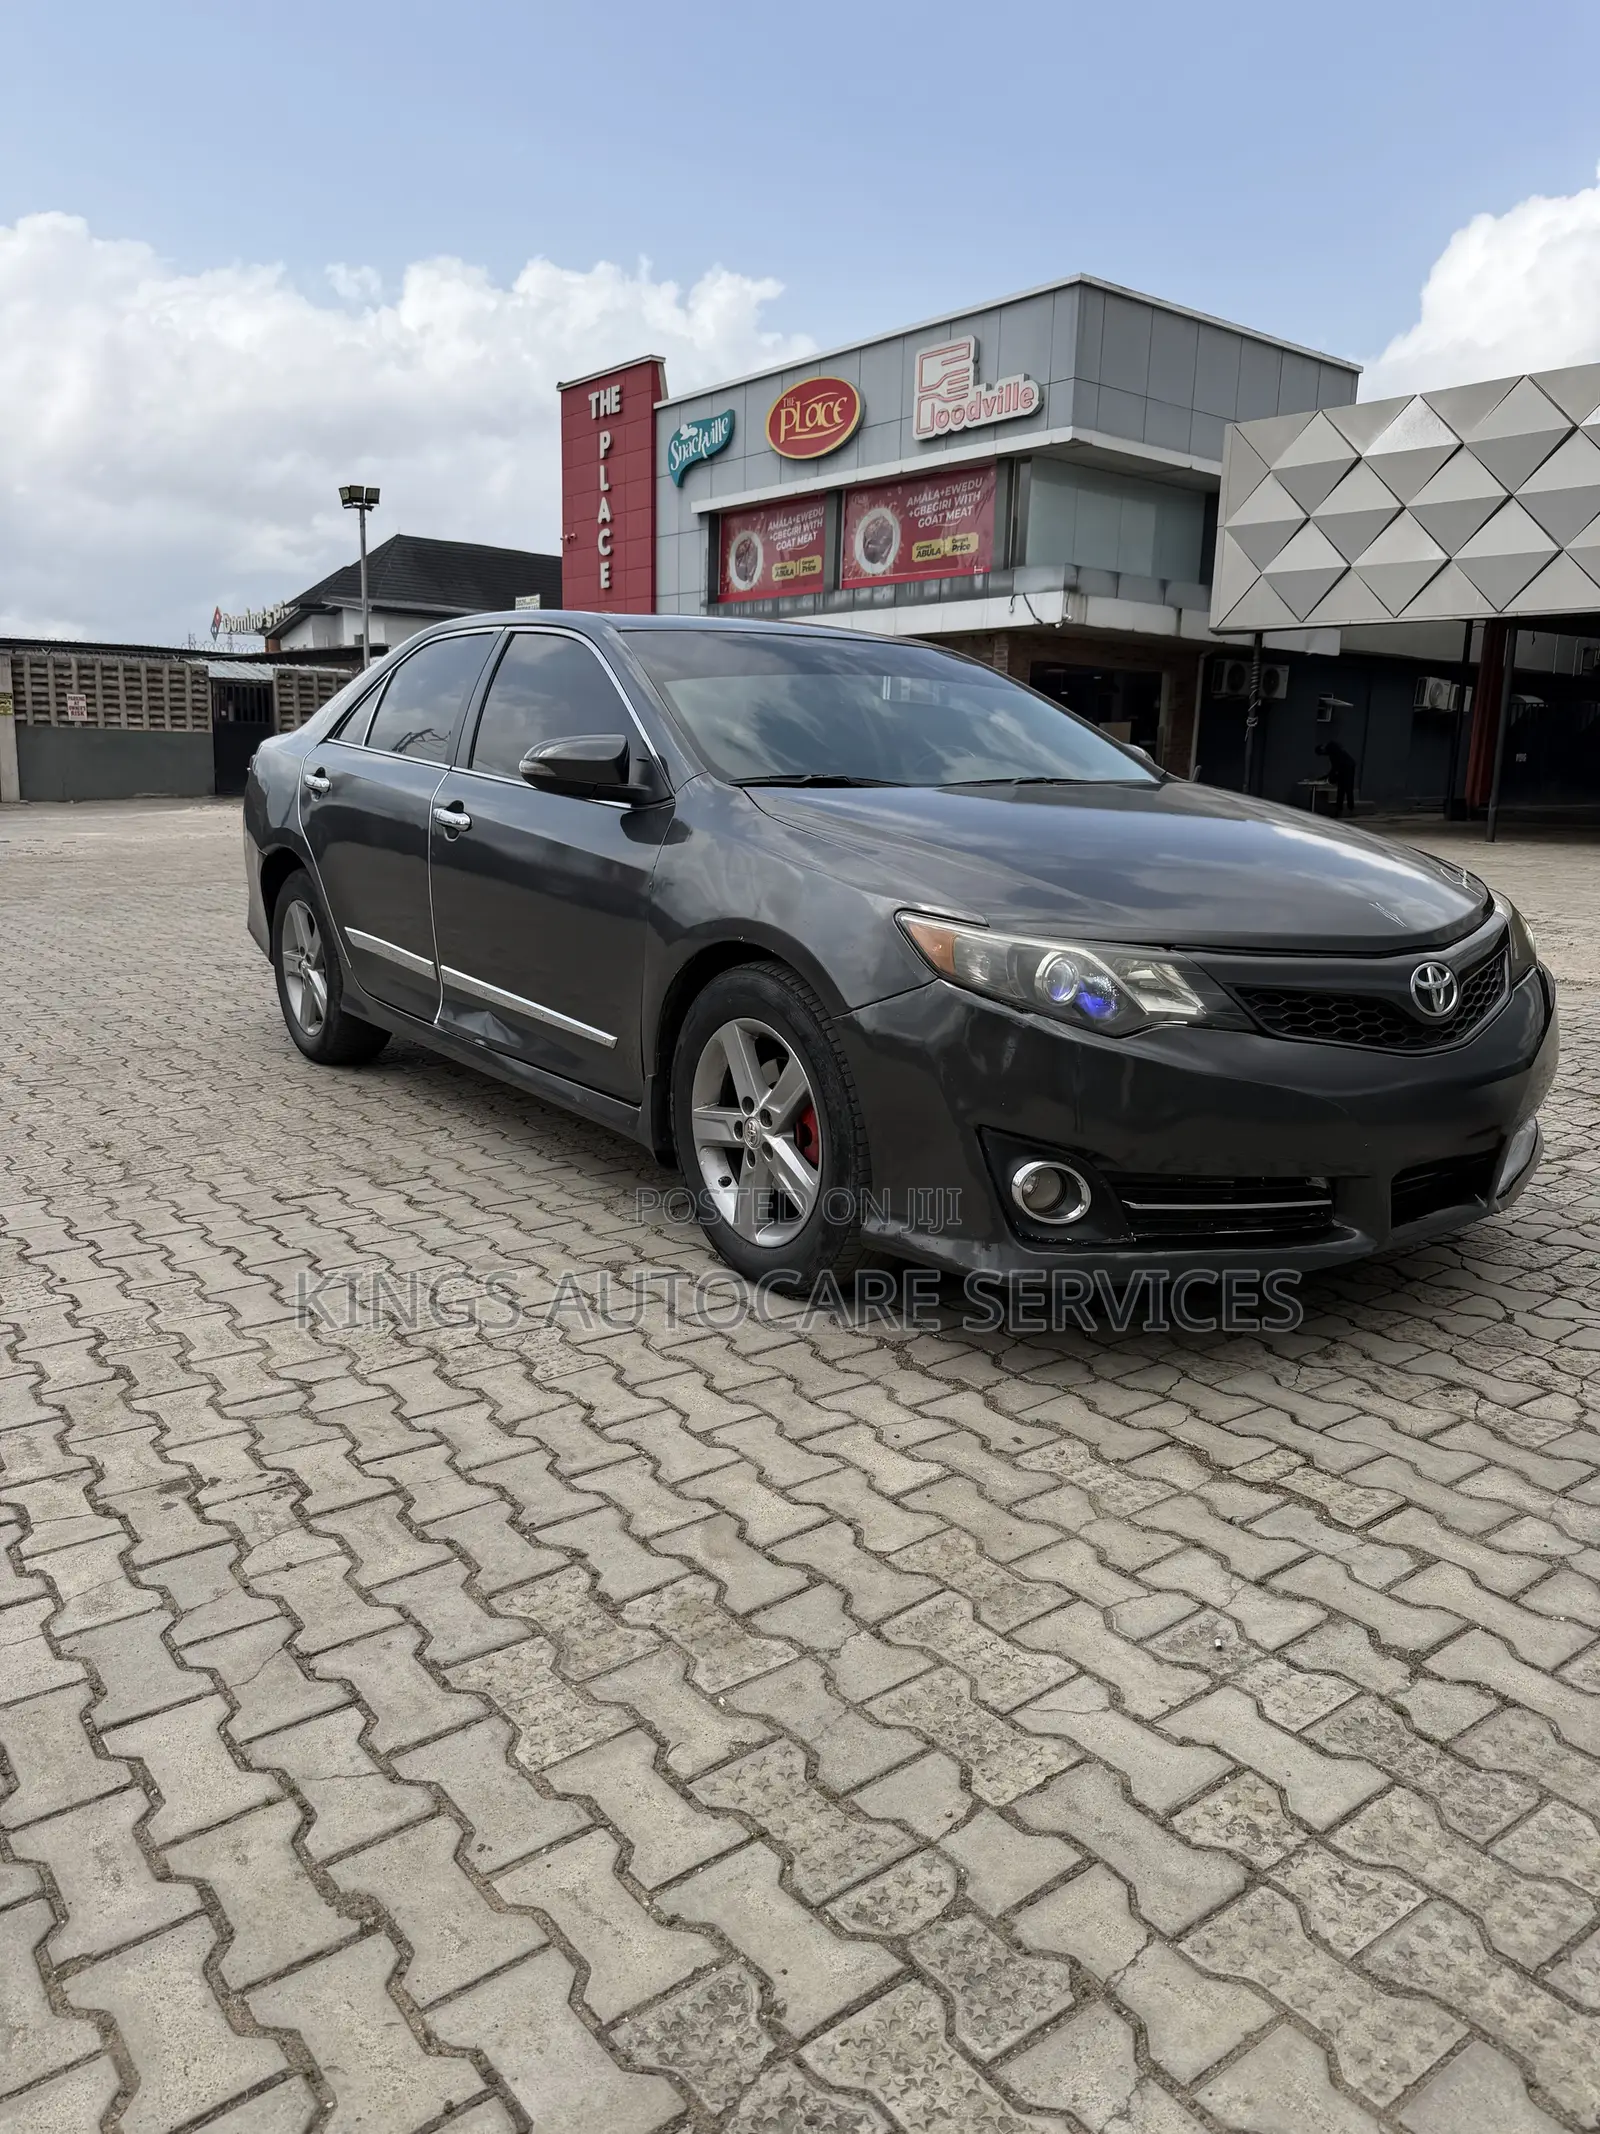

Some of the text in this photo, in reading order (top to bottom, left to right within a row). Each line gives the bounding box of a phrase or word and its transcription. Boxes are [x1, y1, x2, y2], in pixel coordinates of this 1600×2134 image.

[589, 385, 621, 420] THE
[782, 396, 796, 408] THE
[670, 417, 729, 471] Snackville
[954, 490, 981, 506] WITH
[598, 431, 611, 589] PLACE
[918, 505, 974, 529] GOAT MEAT
[803, 517, 823, 533] WITH
[776, 531, 818, 551] GOAT MEAT
[951, 543, 971, 553] Price
[916, 548, 941, 558] ABULA
[221, 605, 273, 633] Domino's
